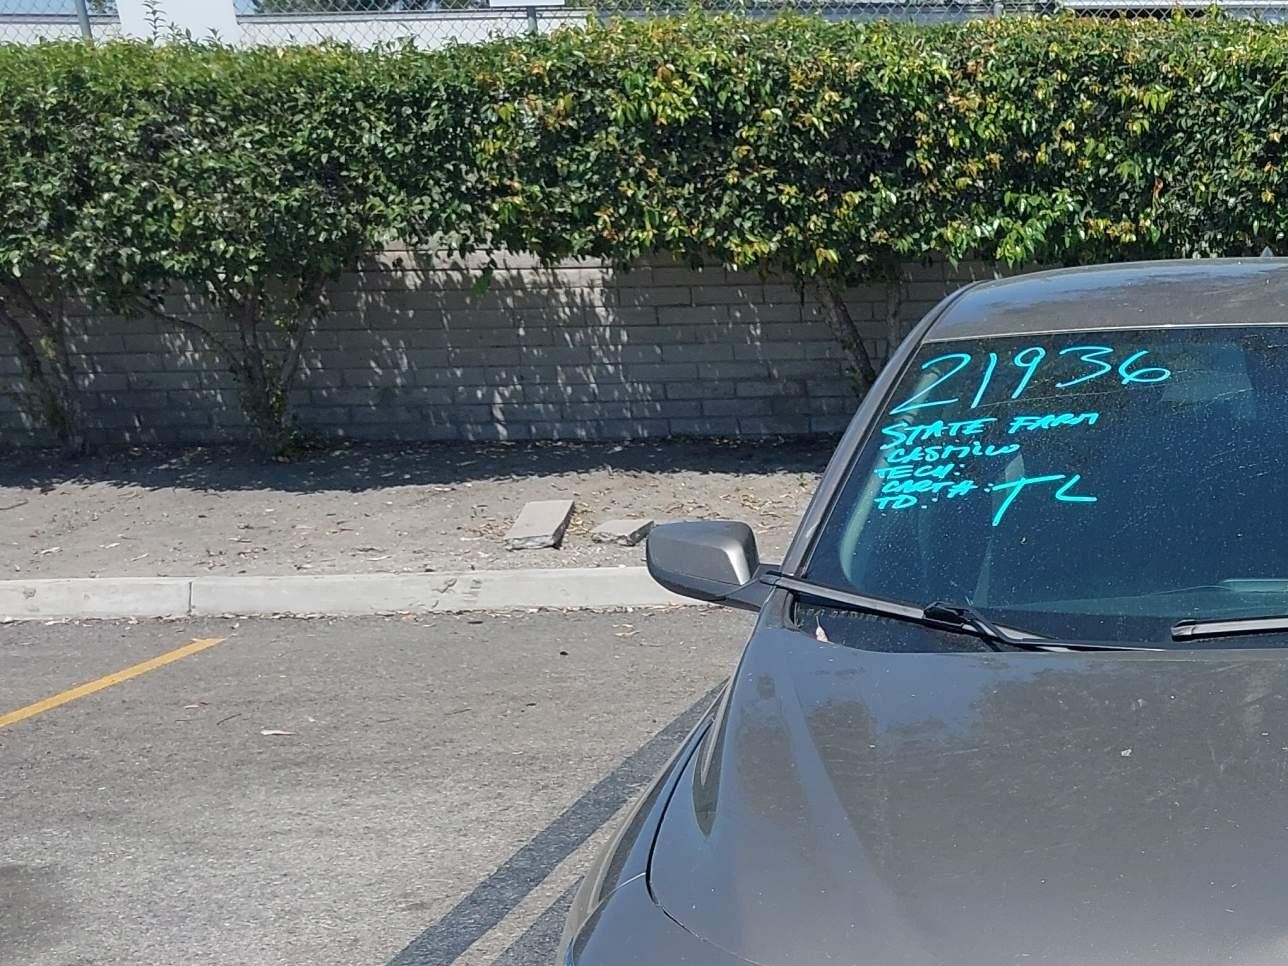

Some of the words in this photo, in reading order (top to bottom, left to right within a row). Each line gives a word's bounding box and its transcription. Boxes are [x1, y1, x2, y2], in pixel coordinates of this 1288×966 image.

[889, 346, 1171, 415] 21936
[879, 417, 998, 450] STATE
[1007, 412, 1099, 434] FARM
